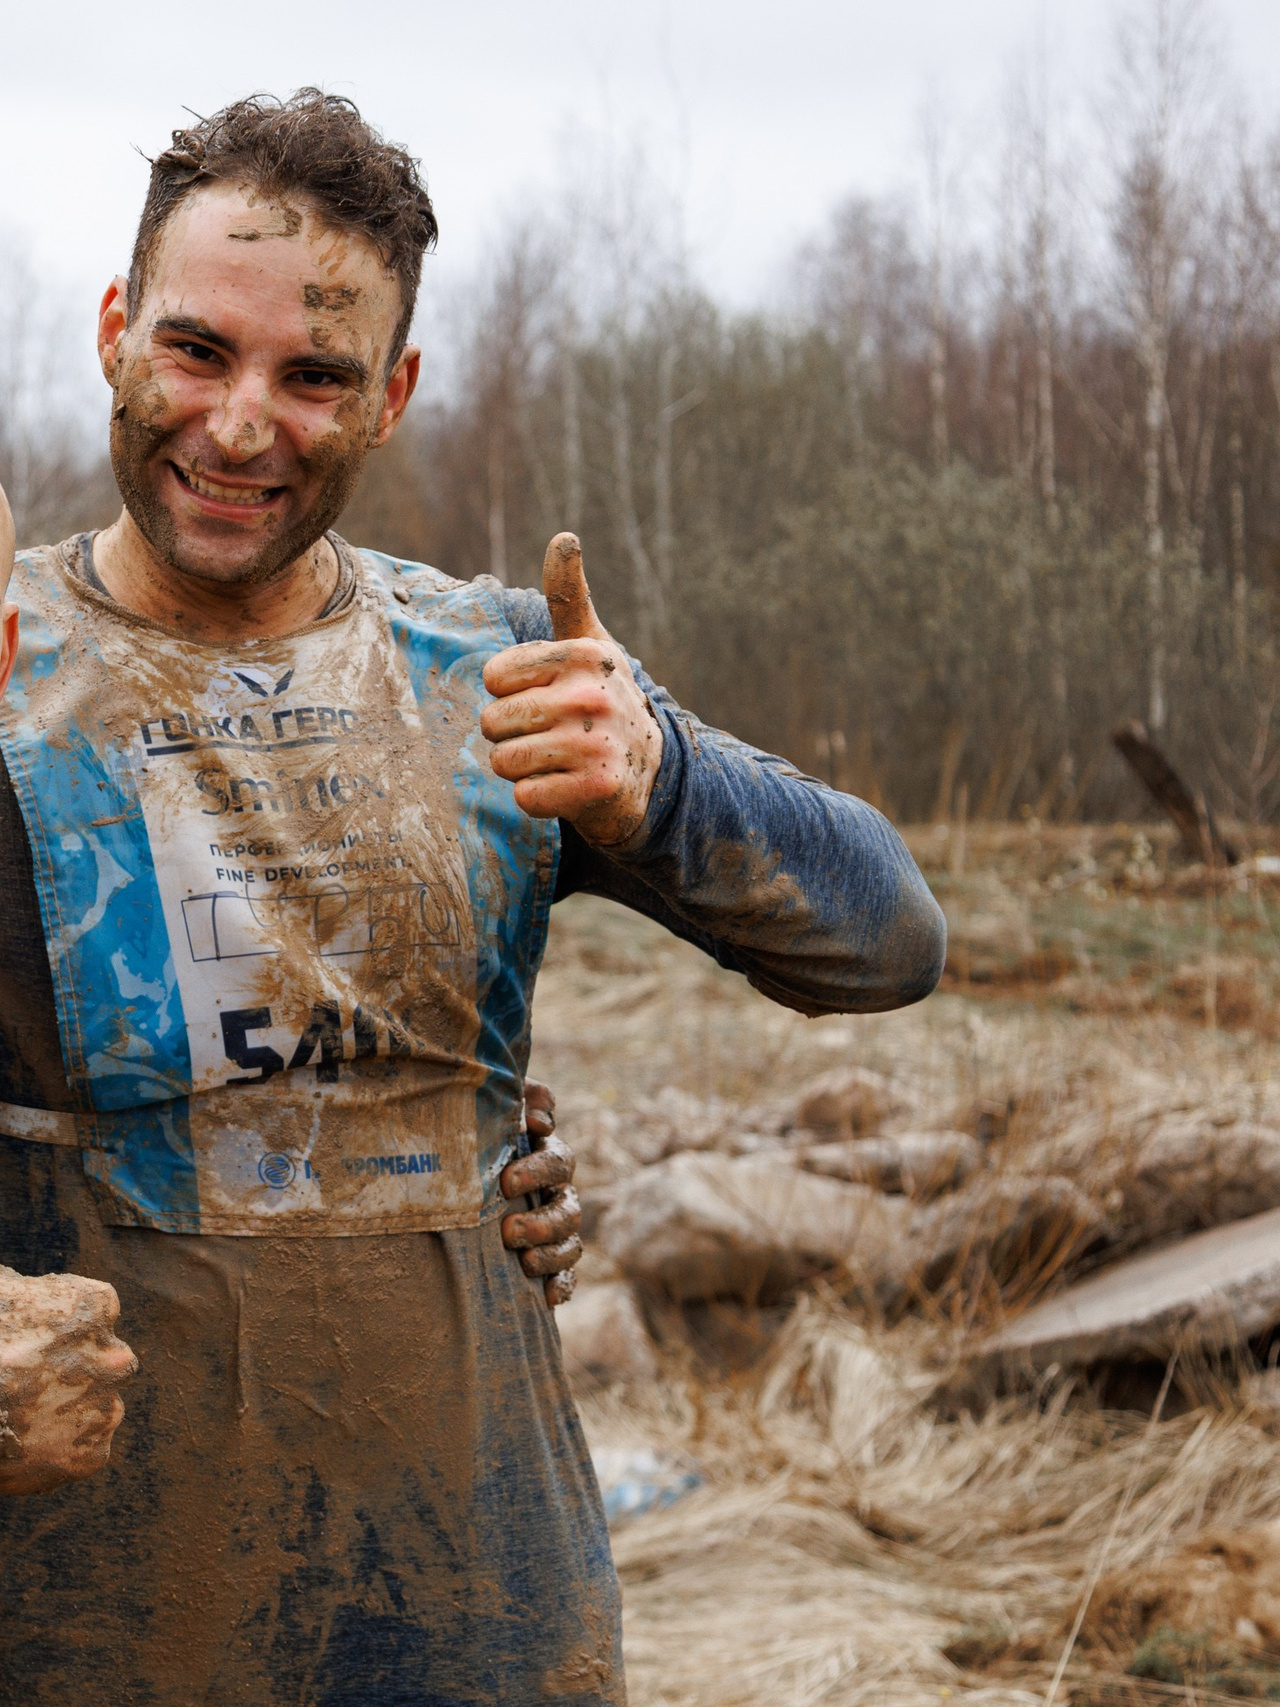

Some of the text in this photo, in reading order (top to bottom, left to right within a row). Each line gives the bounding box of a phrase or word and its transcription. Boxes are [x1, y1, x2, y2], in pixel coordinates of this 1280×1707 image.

[140, 706, 362, 744] ГОНКА ГЕРО
[210, 830, 402, 858] ПЕРФЕИОНИТЫ
[216, 867, 255, 882] FINE
[304, 1153, 442, 1180] ГРОМБАНК
